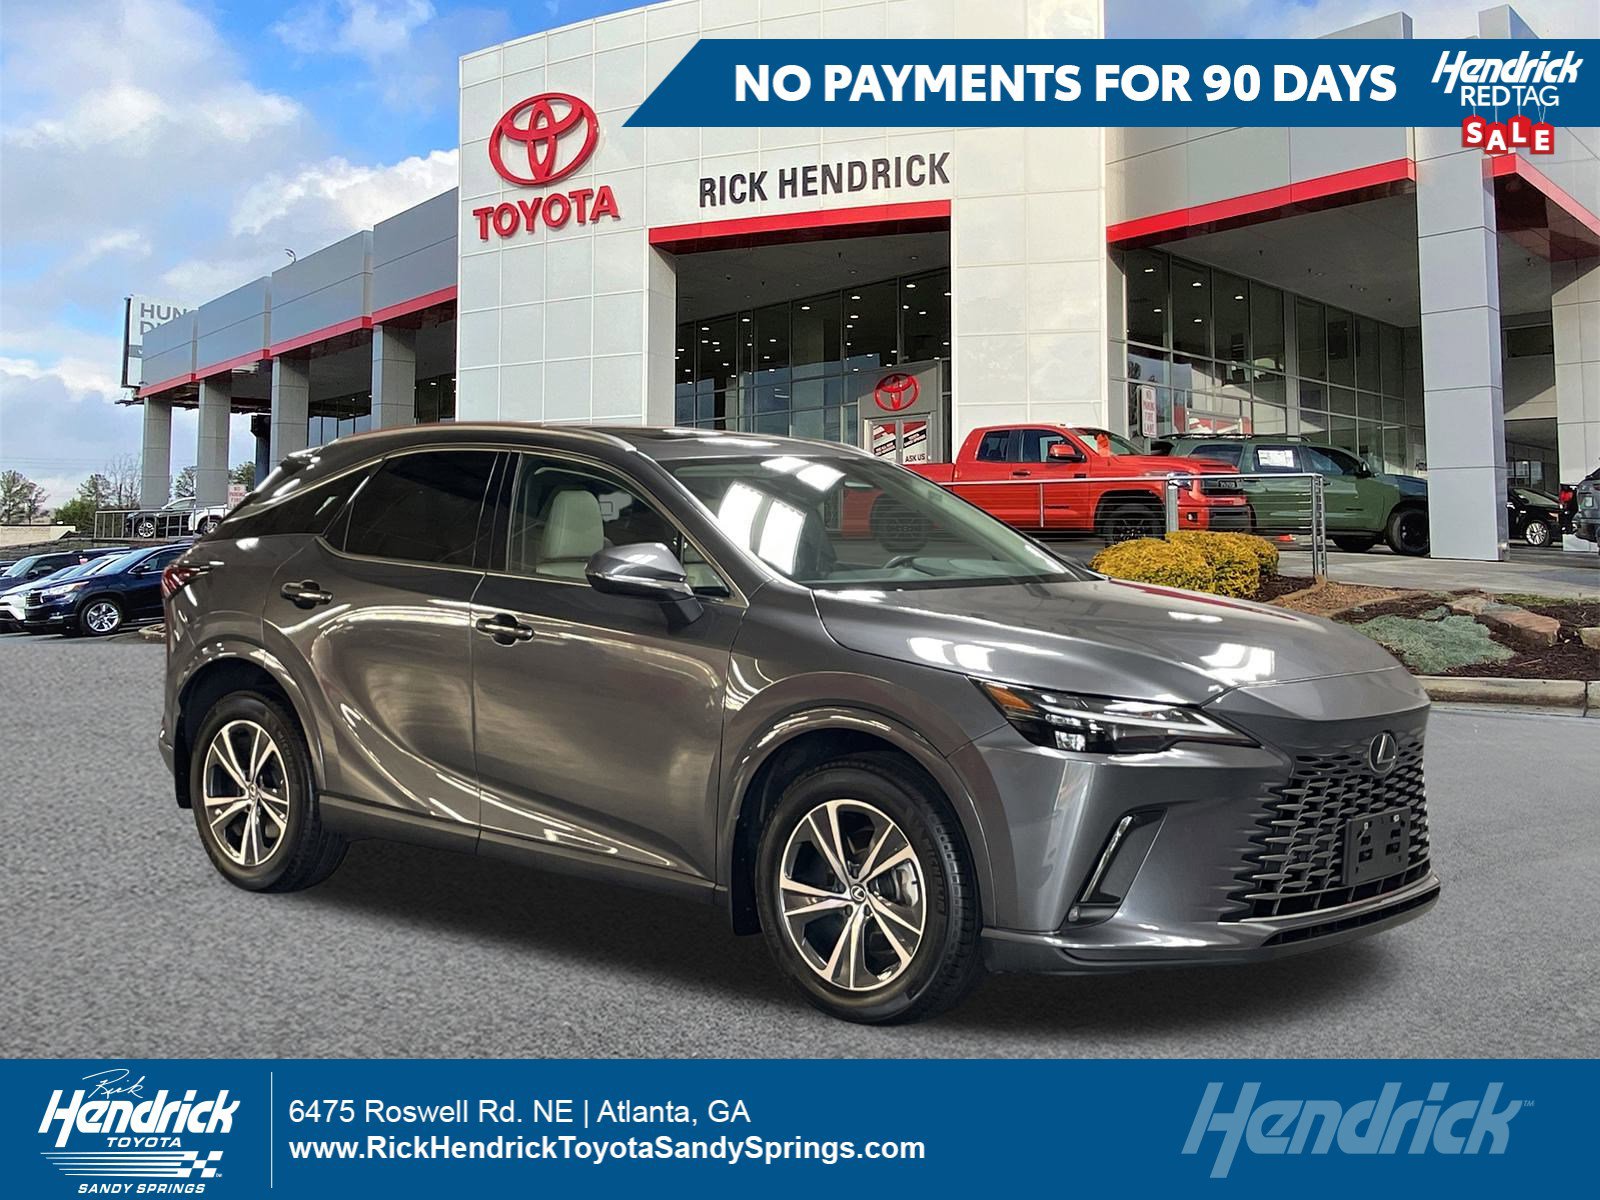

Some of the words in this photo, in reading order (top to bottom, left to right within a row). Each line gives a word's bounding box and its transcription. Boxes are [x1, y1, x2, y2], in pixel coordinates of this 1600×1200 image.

[699, 170, 768, 208] RICK
[778, 152, 950, 200] HENDRICK
[472, 185, 620, 241] TOYOTA
[904, 455, 917, 463] ASK
[917, 453, 926, 461] US
